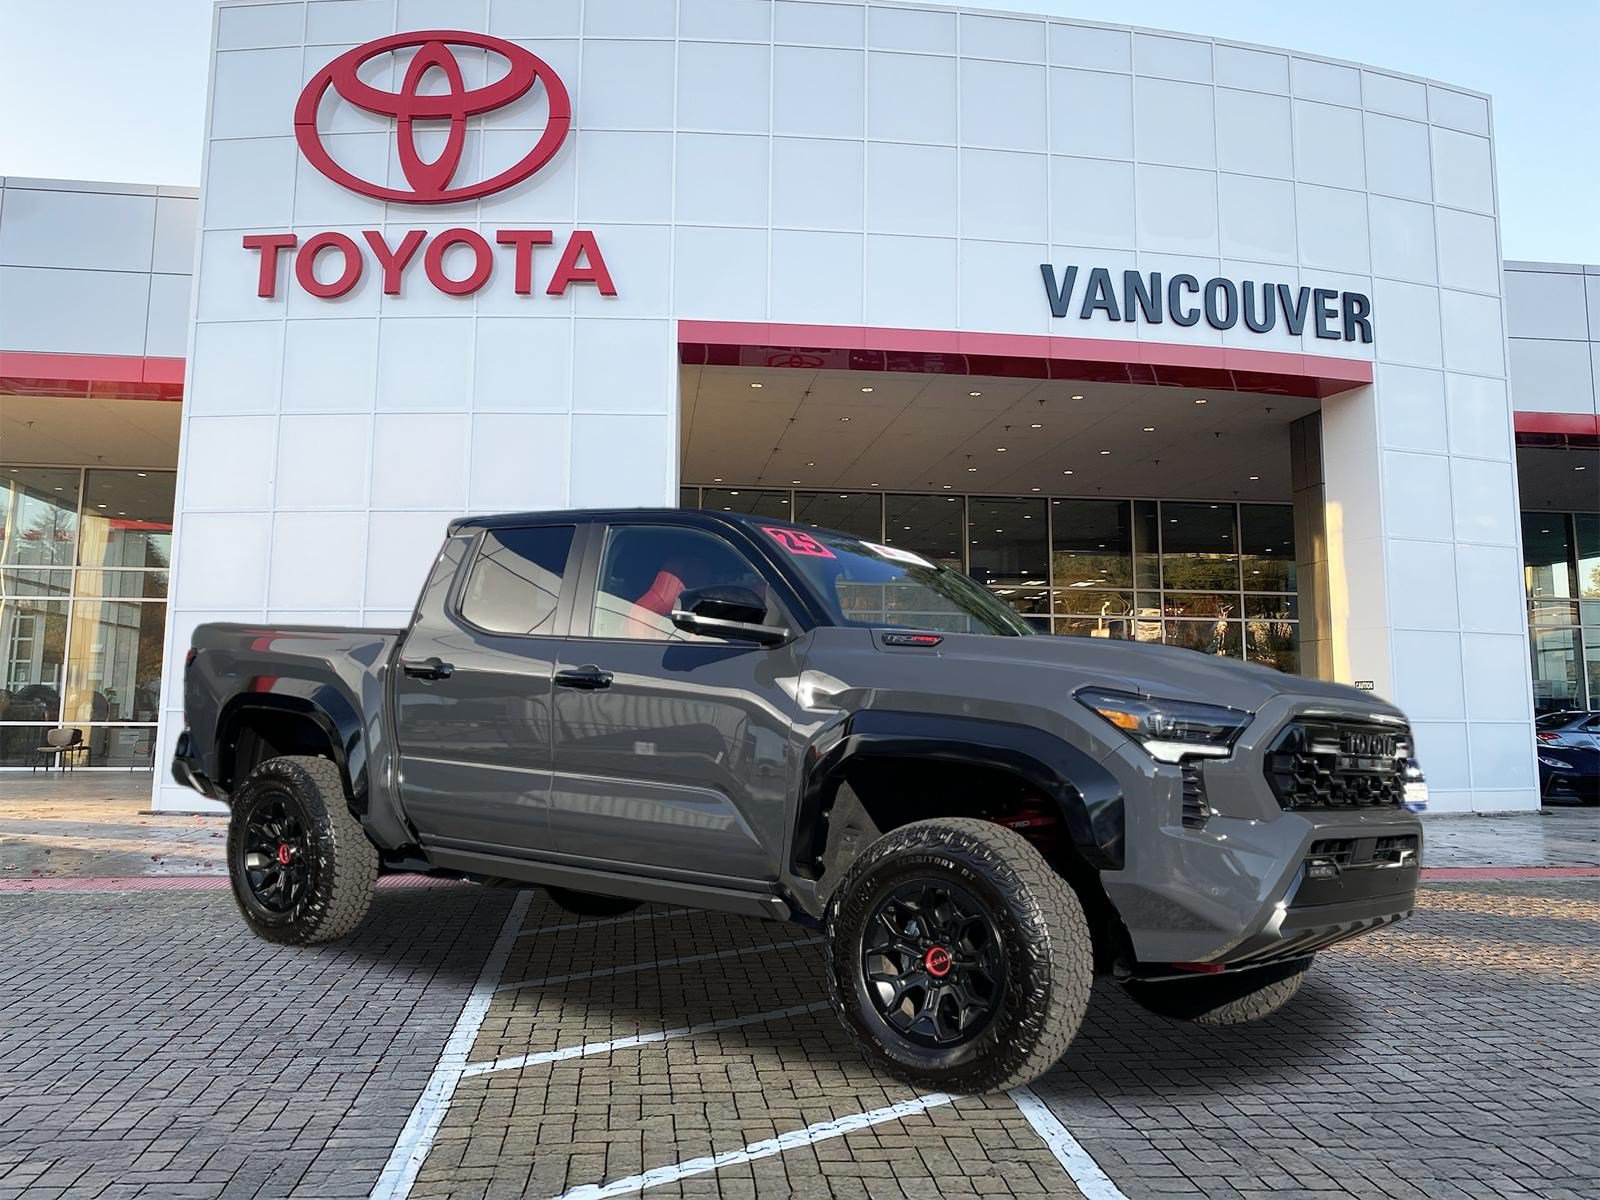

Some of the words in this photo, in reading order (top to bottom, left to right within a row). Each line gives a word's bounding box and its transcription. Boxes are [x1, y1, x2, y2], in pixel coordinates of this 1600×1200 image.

[243, 228, 617, 298] TOYOTA
[1040, 264, 1373, 343] VANCOUVER
[1349, 734, 1395, 755] TOYOTA
